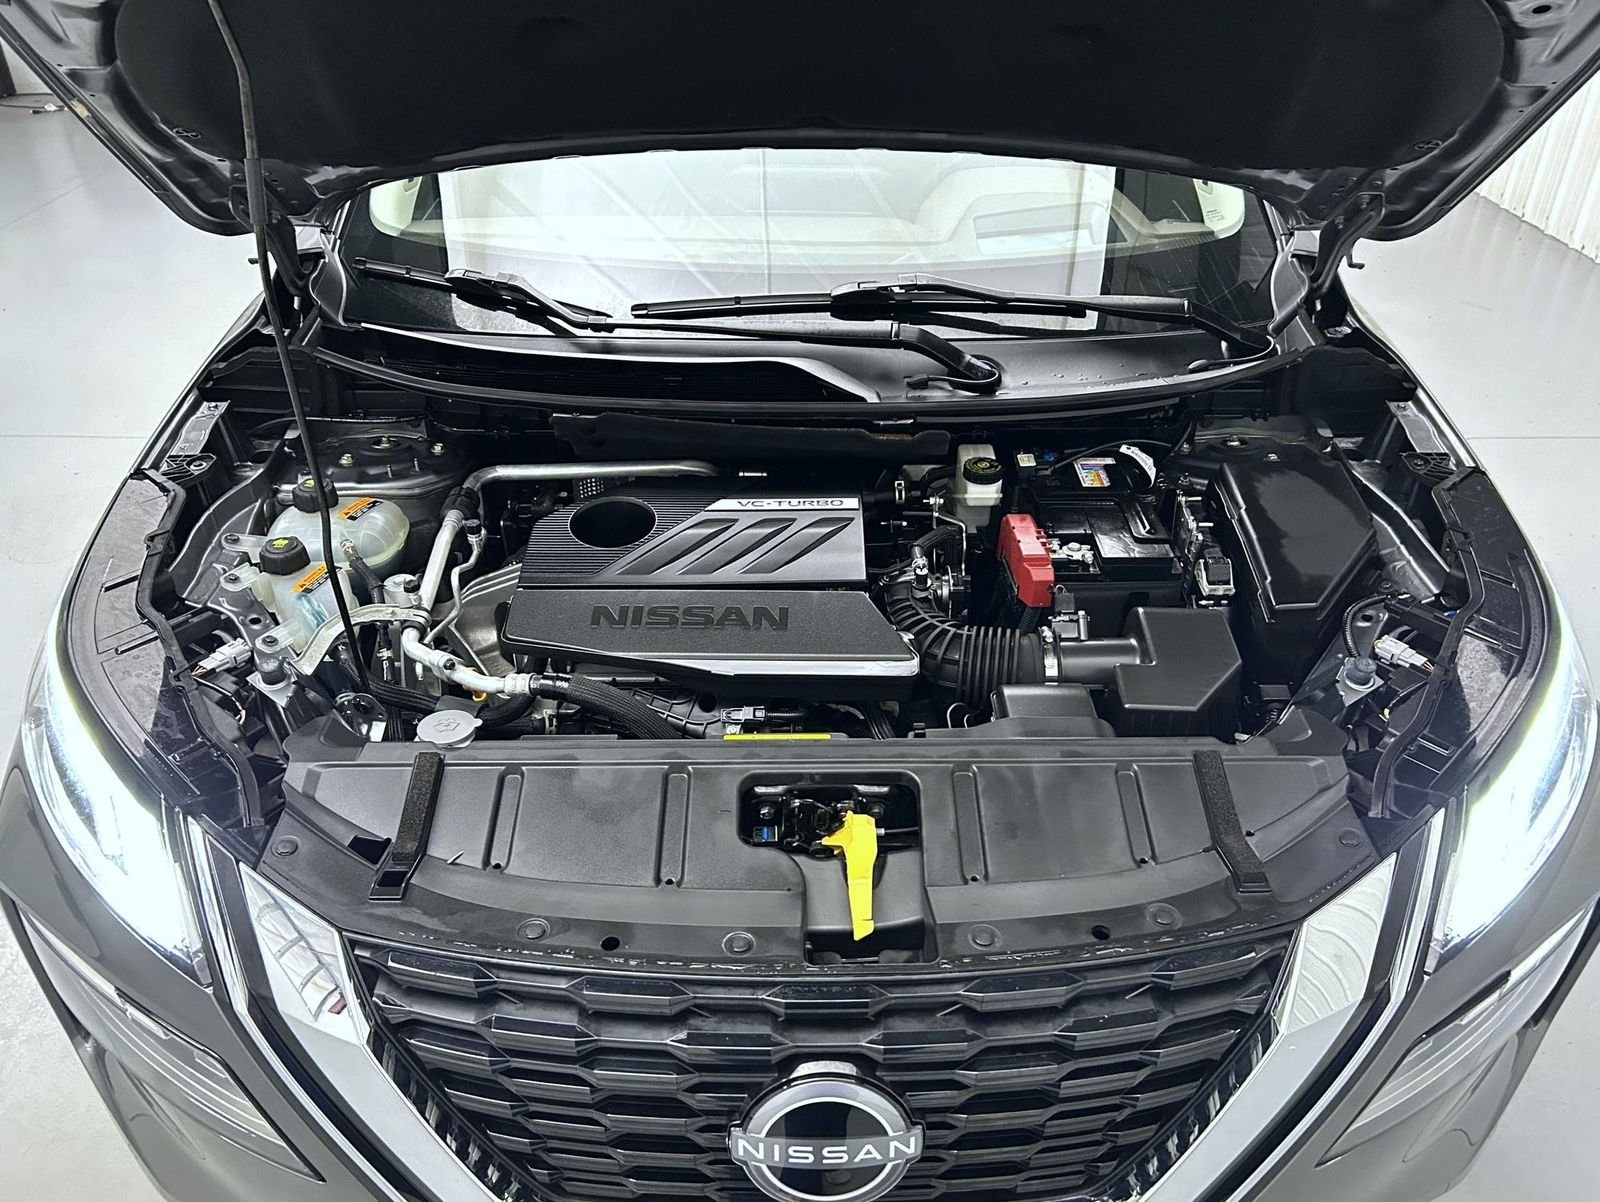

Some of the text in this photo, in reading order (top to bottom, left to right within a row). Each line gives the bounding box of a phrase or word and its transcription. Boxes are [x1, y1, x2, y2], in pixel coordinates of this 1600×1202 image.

[736, 499, 844, 508] VC-TURBO
[589, 604, 790, 631] NISSAN
[737, 1136, 916, 1164] NISSAN
